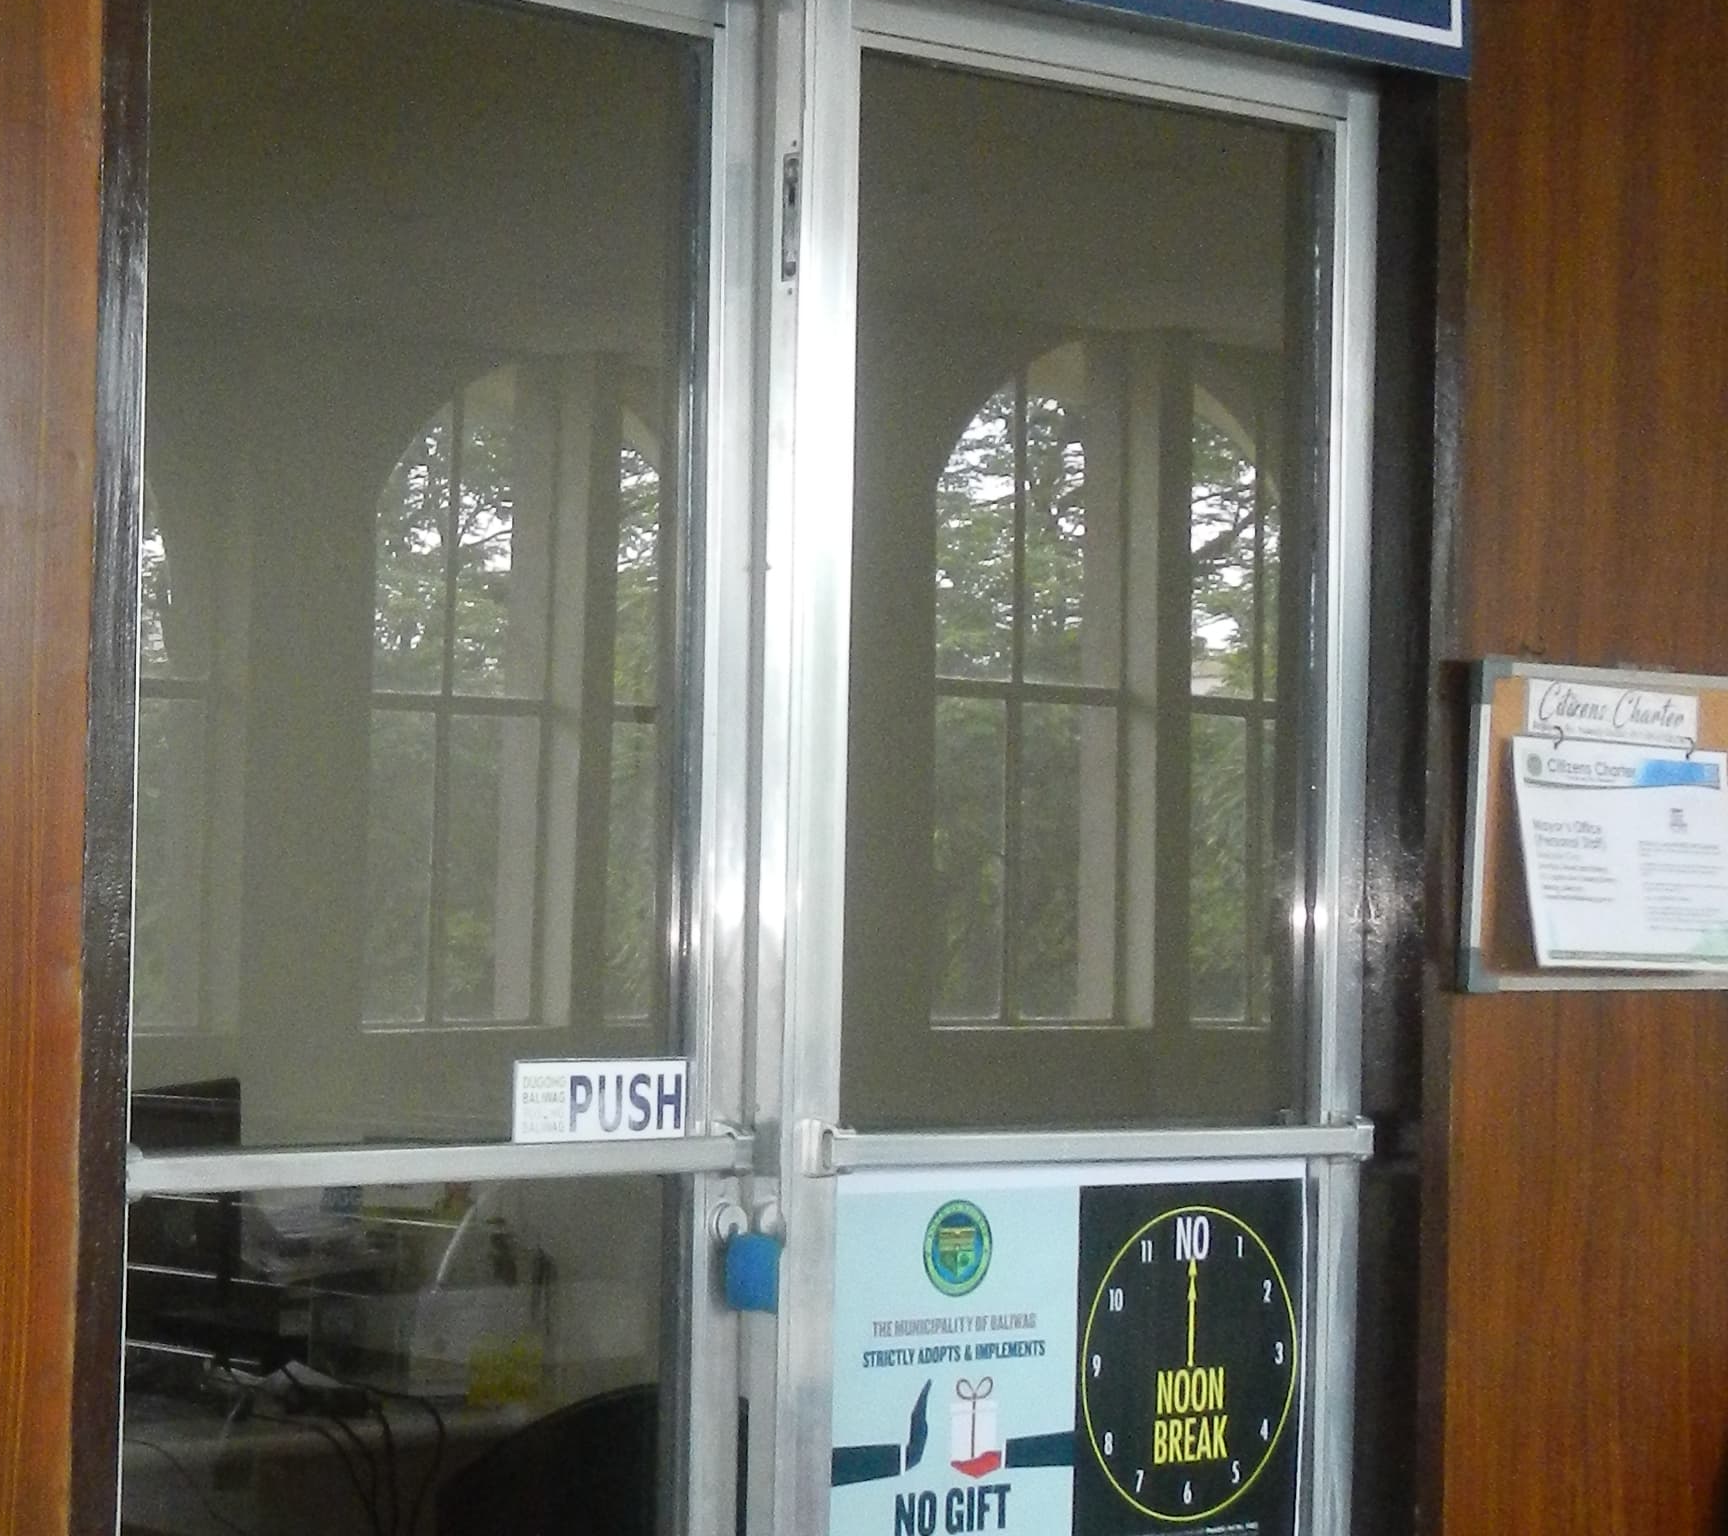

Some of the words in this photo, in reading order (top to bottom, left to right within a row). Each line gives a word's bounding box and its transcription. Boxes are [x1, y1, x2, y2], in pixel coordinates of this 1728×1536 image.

[522, 1091, 567, 1105] BALIWAG
[569, 1073, 683, 1133] PUSH
[1175, 1215, 1211, 1261] NO
[1236, 1235, 1244, 1258] 1
[1140, 1239, 1154, 1263] 11
[1108, 1287, 1125, 1313] 10
[1262, 1278, 1273, 1304] 2
[873, 1320, 893, 1338] THE
[894, 1315, 973, 1337] MUNICIPALITY
[975, 1314, 988, 1332] OF
[862, 1347, 916, 1369] STRICTLY
[917, 1344, 962, 1366] ADOPTS
[963, 1343, 973, 1362] &
[975, 1340, 1046, 1361] IMPLEMENTS
[1092, 1353, 1102, 1378] 9
[1274, 1341, 1285, 1365] 3
[1156, 1366, 1226, 1416] NOON
[1152, 1414, 1229, 1465] BREAK
[1259, 1418, 1270, 1442] 4
[1103, 1431, 1114, 1457] 8
[1135, 1468, 1146, 1493] 7
[1231, 1460, 1241, 1485] 5
[1183, 1480, 1193, 1505] 6
[944, 1483, 1012, 1535] GIFT
